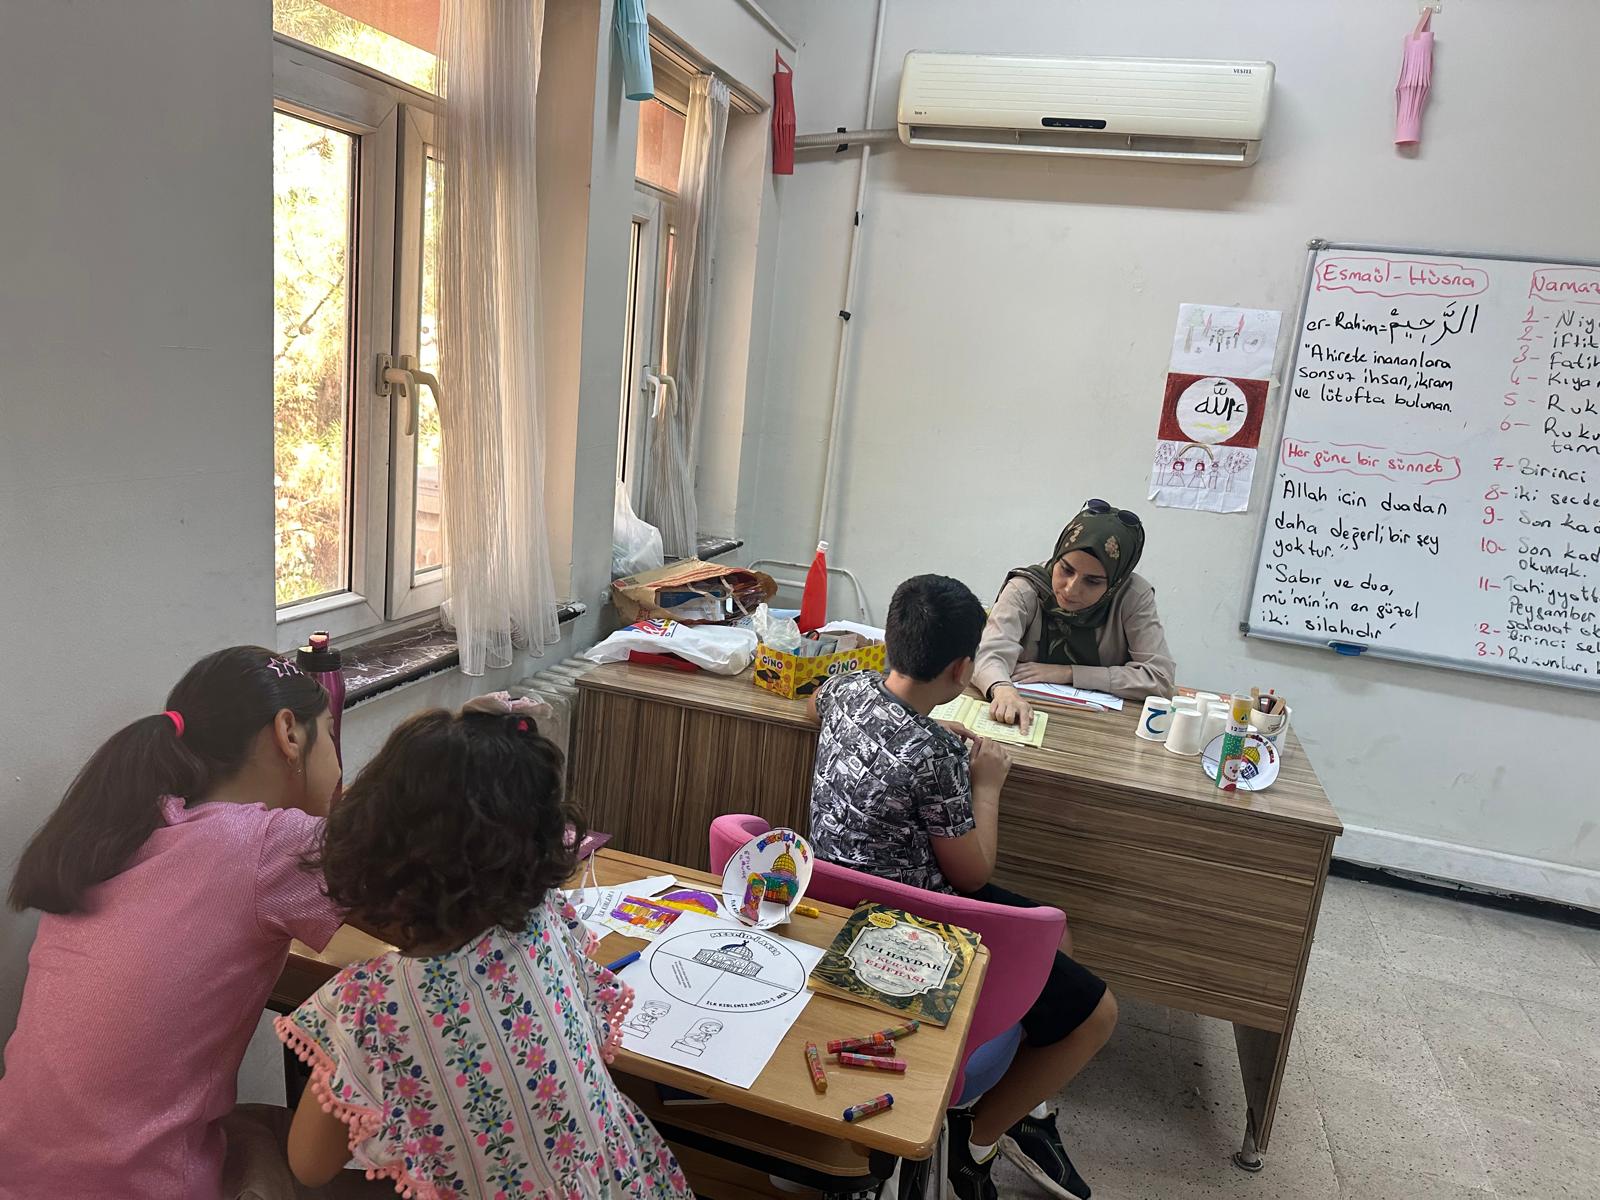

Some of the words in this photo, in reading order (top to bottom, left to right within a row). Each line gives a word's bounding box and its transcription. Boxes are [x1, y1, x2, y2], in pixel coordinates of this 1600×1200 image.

[1556, 309, 1600, 334] Niy
[1373, 351, 1452, 369] inananlara
[1295, 387, 1311, 399] ve
[1288, 443, 1310, 457] Her
[1314, 450, 1351, 467] güne
[1358, 451, 1379, 467] bir
[1388, 458, 1443, 473] sünnet
[1518, 458, 1586, 483] Birinci
[1381, 493, 1447, 515] duadan
[1275, 511, 1318, 535] daha
[1389, 526, 1411, 544] bir
[1334, 578, 1354, 589] ve
[1262, 610, 1289, 625] iki
[1351, 603, 1369, 613] en
[1376, 601, 1419, 619] güzel
